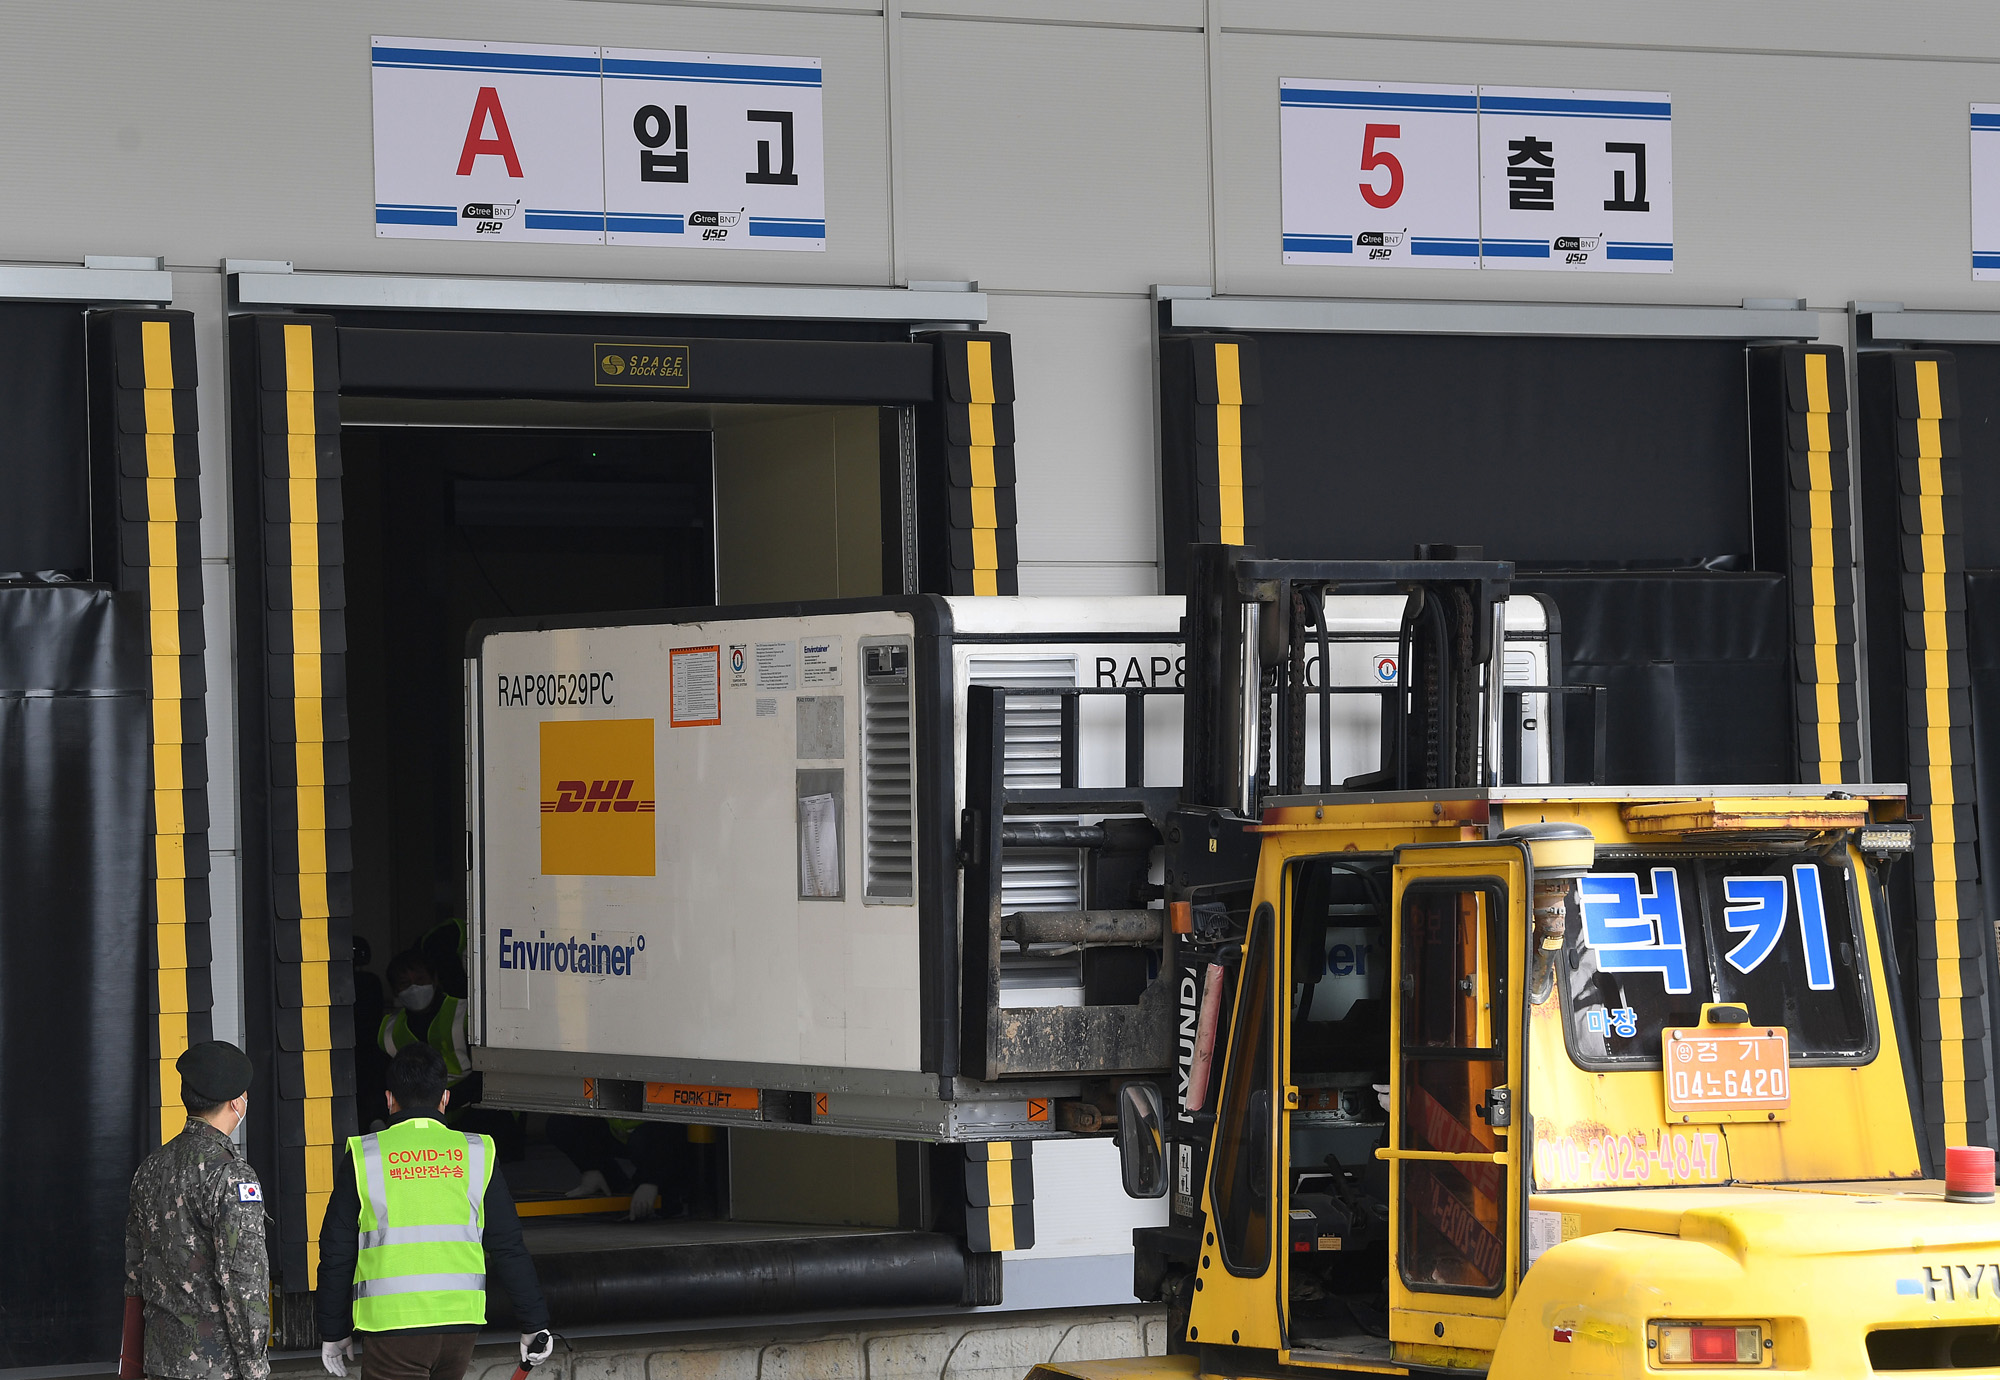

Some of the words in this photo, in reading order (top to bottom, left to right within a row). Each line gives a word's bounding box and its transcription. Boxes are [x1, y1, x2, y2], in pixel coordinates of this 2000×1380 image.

[456, 86, 524, 178] A
[1358, 123, 1404, 209] 5
[494, 208, 511, 216] BNT
[629, 355, 683, 368] SPACE
[630, 367, 658, 376] DOCK
[660, 367, 684, 377] SEAL
[498, 672, 614, 707] RAP80529PC
[554, 780, 640, 812] DHL
[1577, 863, 1835, 995] 럭키
[1587, 1007, 1638, 1037] 마장
[674, 1089, 703, 1106] FORK
[707, 1091, 732, 1107] LIFT
[1675, 1068, 1784, 1098] 04노6420
[388, 1149, 463, 1164] COVID-19
[1537, 1133, 1719, 1182] 010-2025-4847
